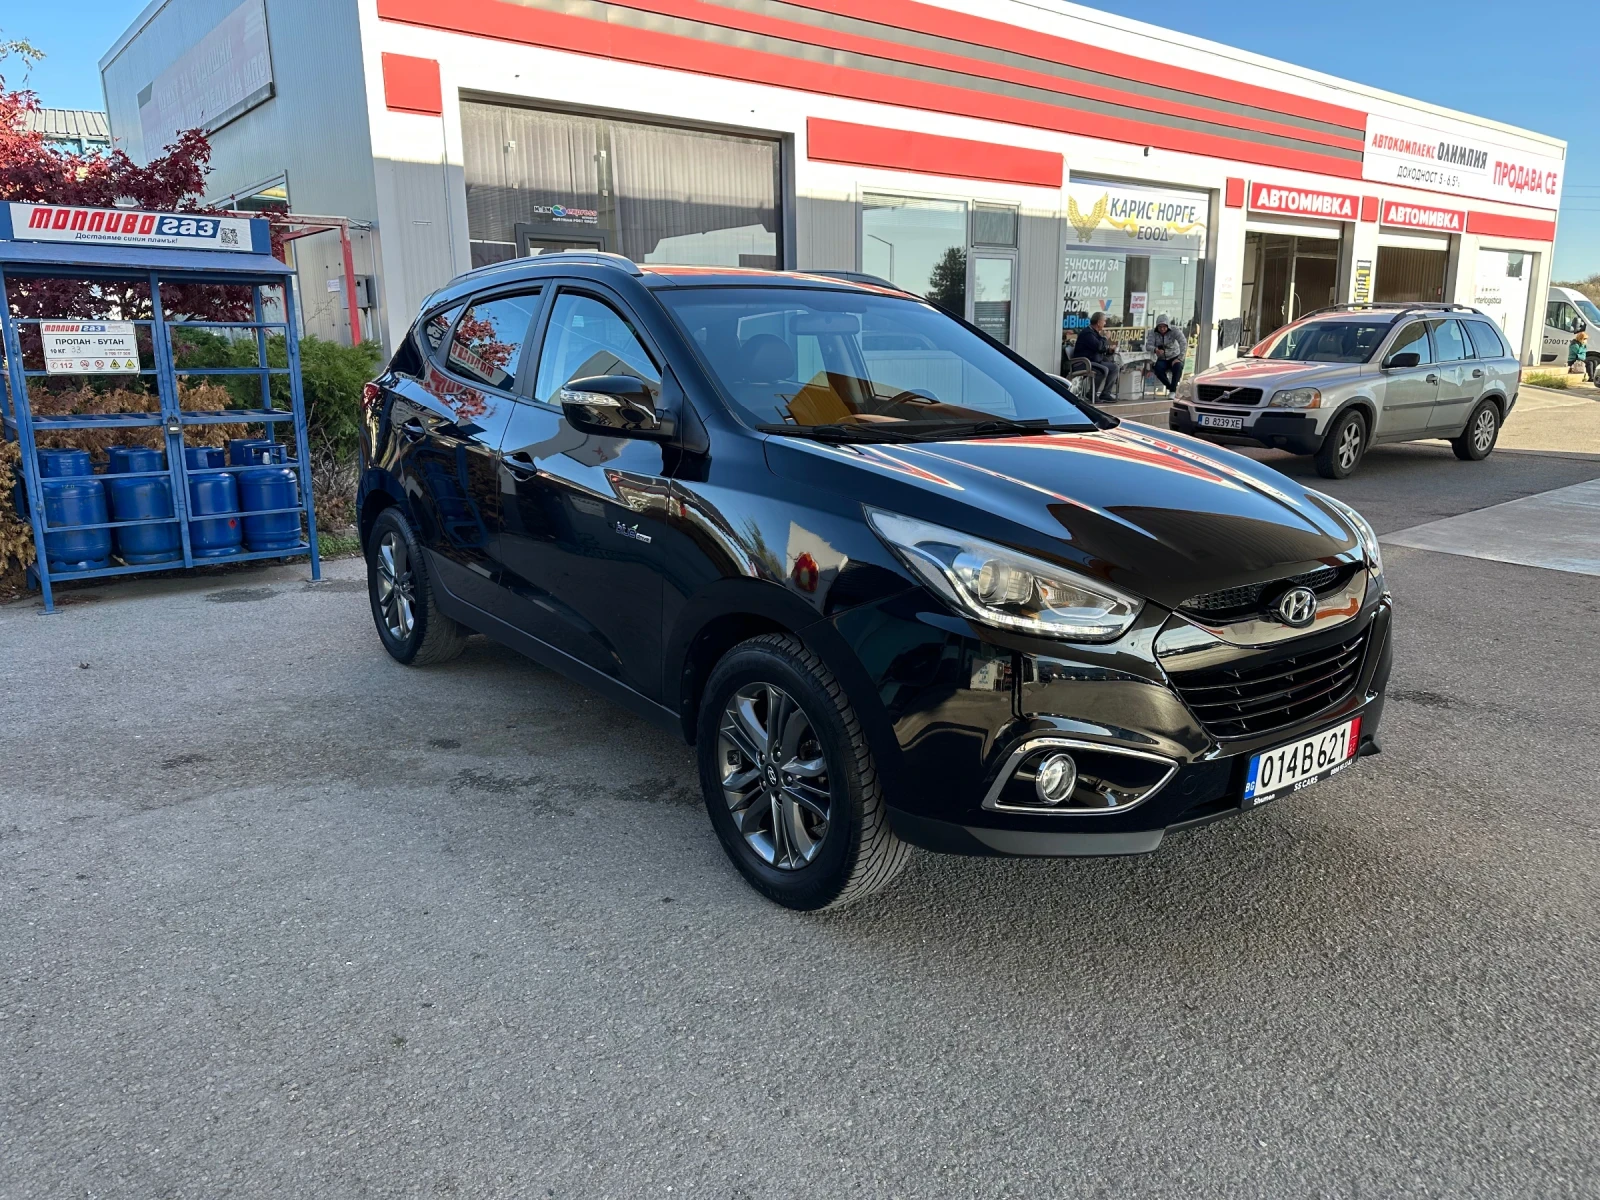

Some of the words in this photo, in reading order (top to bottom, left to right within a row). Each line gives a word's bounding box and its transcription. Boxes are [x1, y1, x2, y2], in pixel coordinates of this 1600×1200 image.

[1371, 133, 1436, 159] АВТОКОМПЛЕКС
[1437, 142, 1488, 170] ОЛИМПИЯ
[1396, 165, 1438, 184] ДОХОДНОСТ
[1493, 161, 1542, 194] ПРОДАВА
[1545, 172, 1557, 195] СЕ
[1257, 187, 1352, 217] АВТОМИВКА
[1109, 197, 1154, 220] КАРИС
[1156, 202, 1197, 223] НОРГЕ
[1387, 205, 1460, 229] АВТОМИВКА
[75, 232, 122, 241] Доставяме
[1137, 225, 1169, 242] ЕООД
[1064, 257, 1105, 271] ЕЧНОСТИ
[1107, 259, 1119, 271] ЗА
[1063, 285, 1109, 298] НТИФРИЗ
[1063, 300, 1090, 312] АСЛА
[1063, 315, 1091, 329] dBlue
[1204, 417, 1210, 425] B
[1212, 418, 1230, 427] 8239
[1230, 419, 1241, 428] XE
[1245, 781, 1256, 793] BG
[1253, 793, 1276, 806] Shumen
